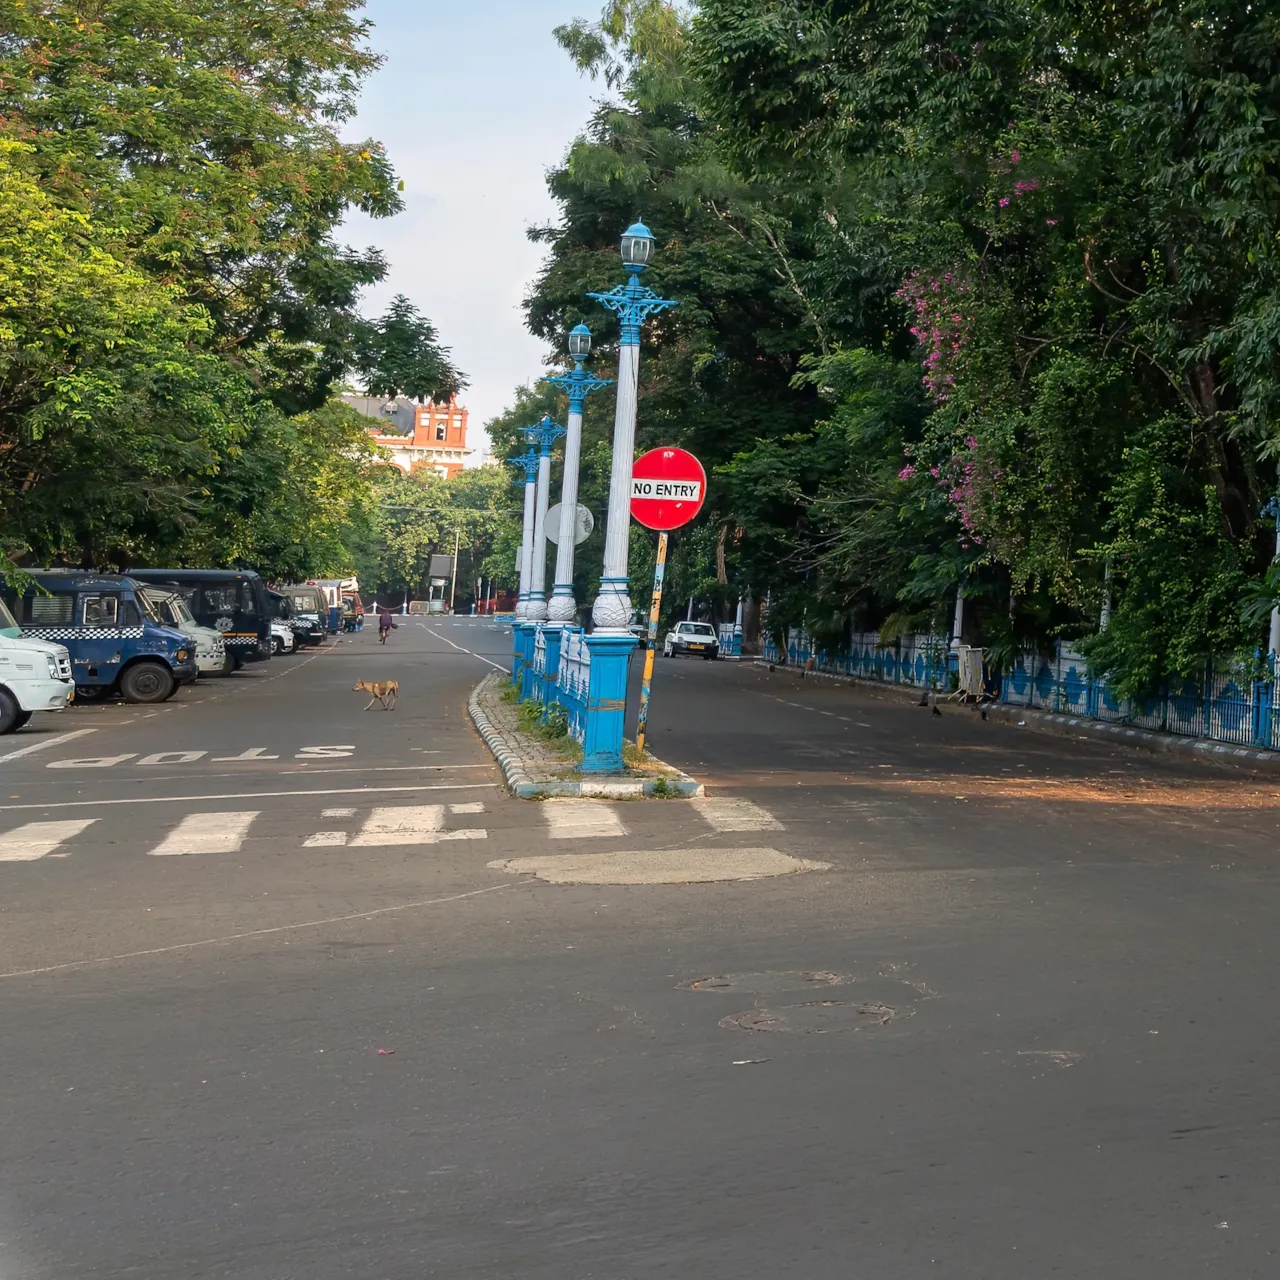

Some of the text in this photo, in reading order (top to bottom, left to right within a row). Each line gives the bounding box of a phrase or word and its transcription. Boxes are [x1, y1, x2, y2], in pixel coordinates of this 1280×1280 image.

[633, 483, 696, 496] NO ENTRY
[46, 746, 355, 768] STOP
